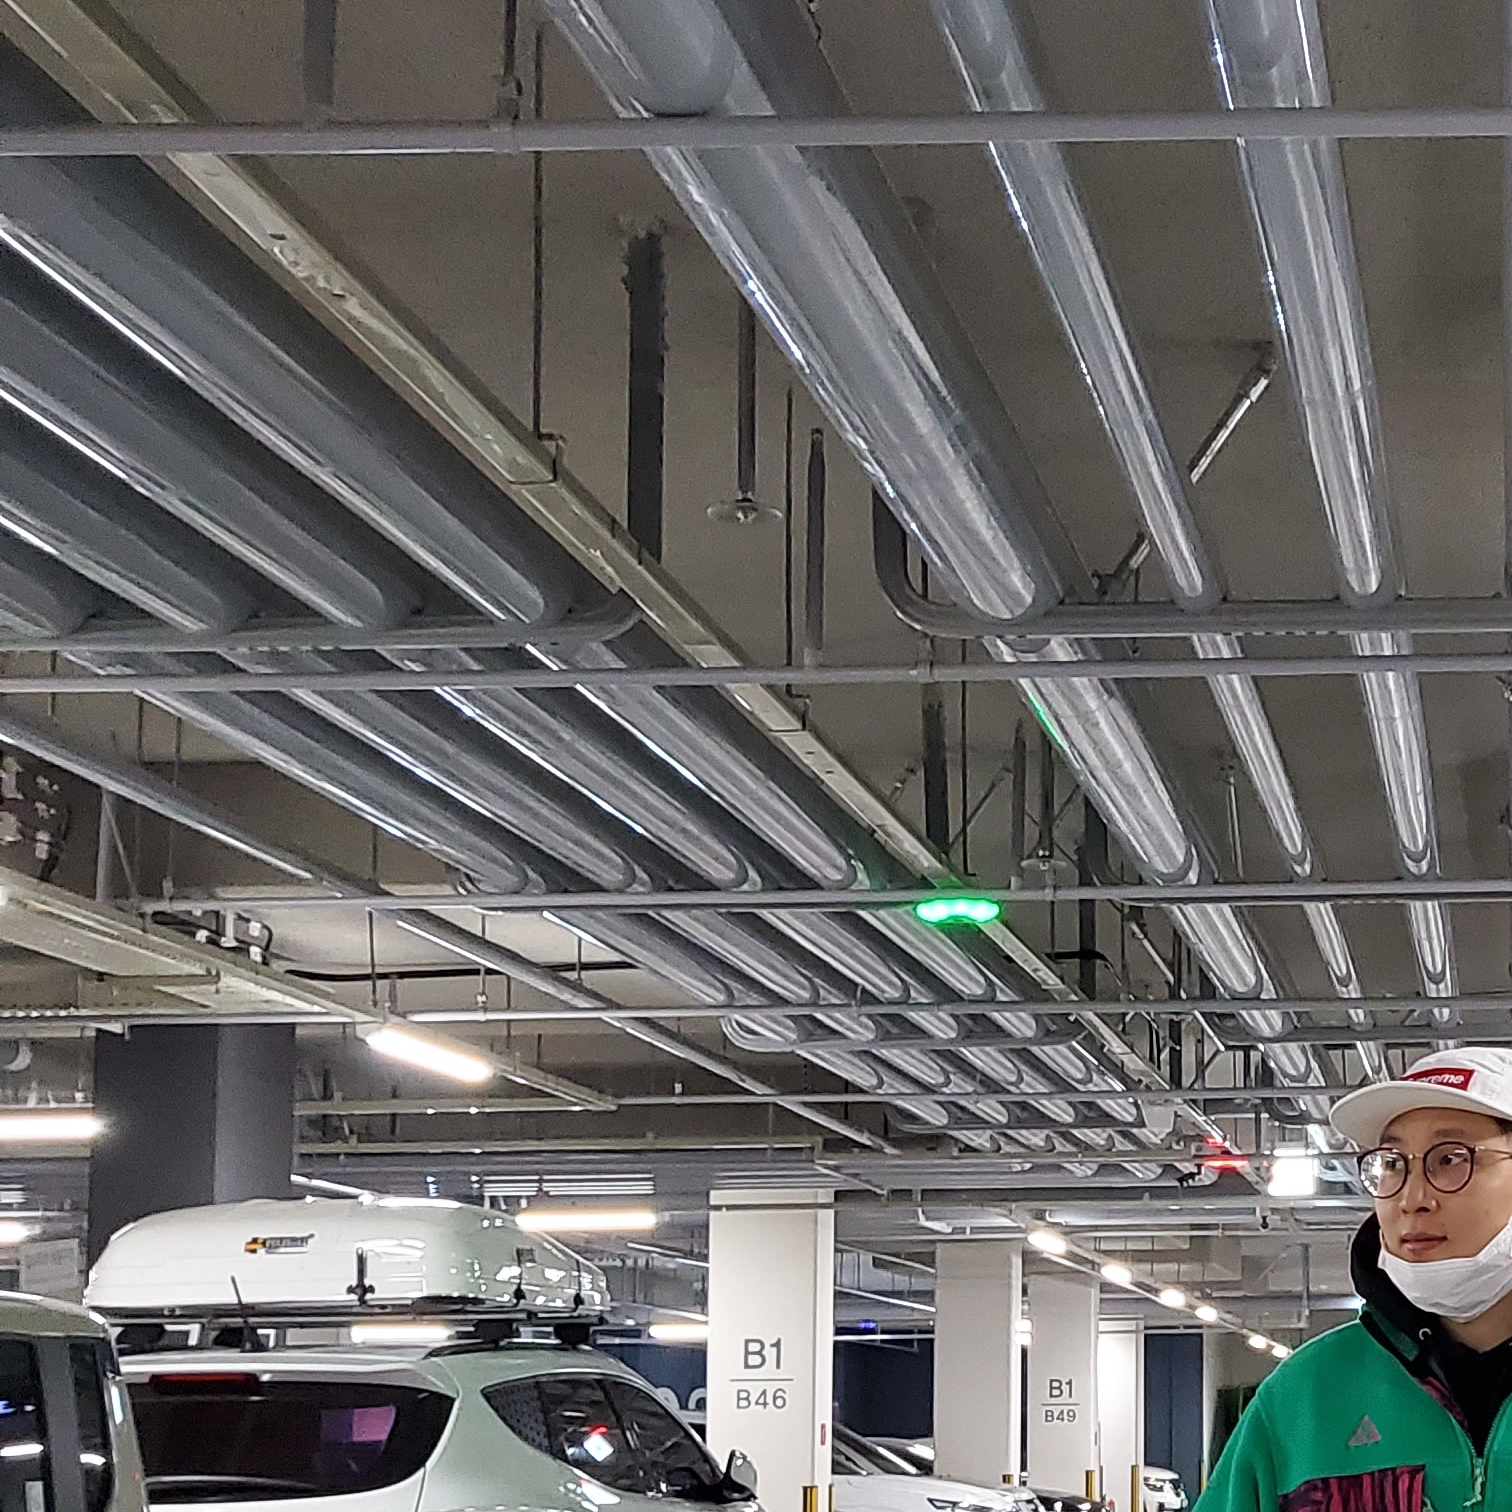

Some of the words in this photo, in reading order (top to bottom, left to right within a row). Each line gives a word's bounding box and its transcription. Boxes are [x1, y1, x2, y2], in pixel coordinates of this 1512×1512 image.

[1407, 1073, 1465, 1085] reme
[743, 1337, 782, 1370] B1
[736, 1387, 788, 1410] B46
[1049, 1378, 1073, 1399] B1
[1044, 1408, 1077, 1423] B49
